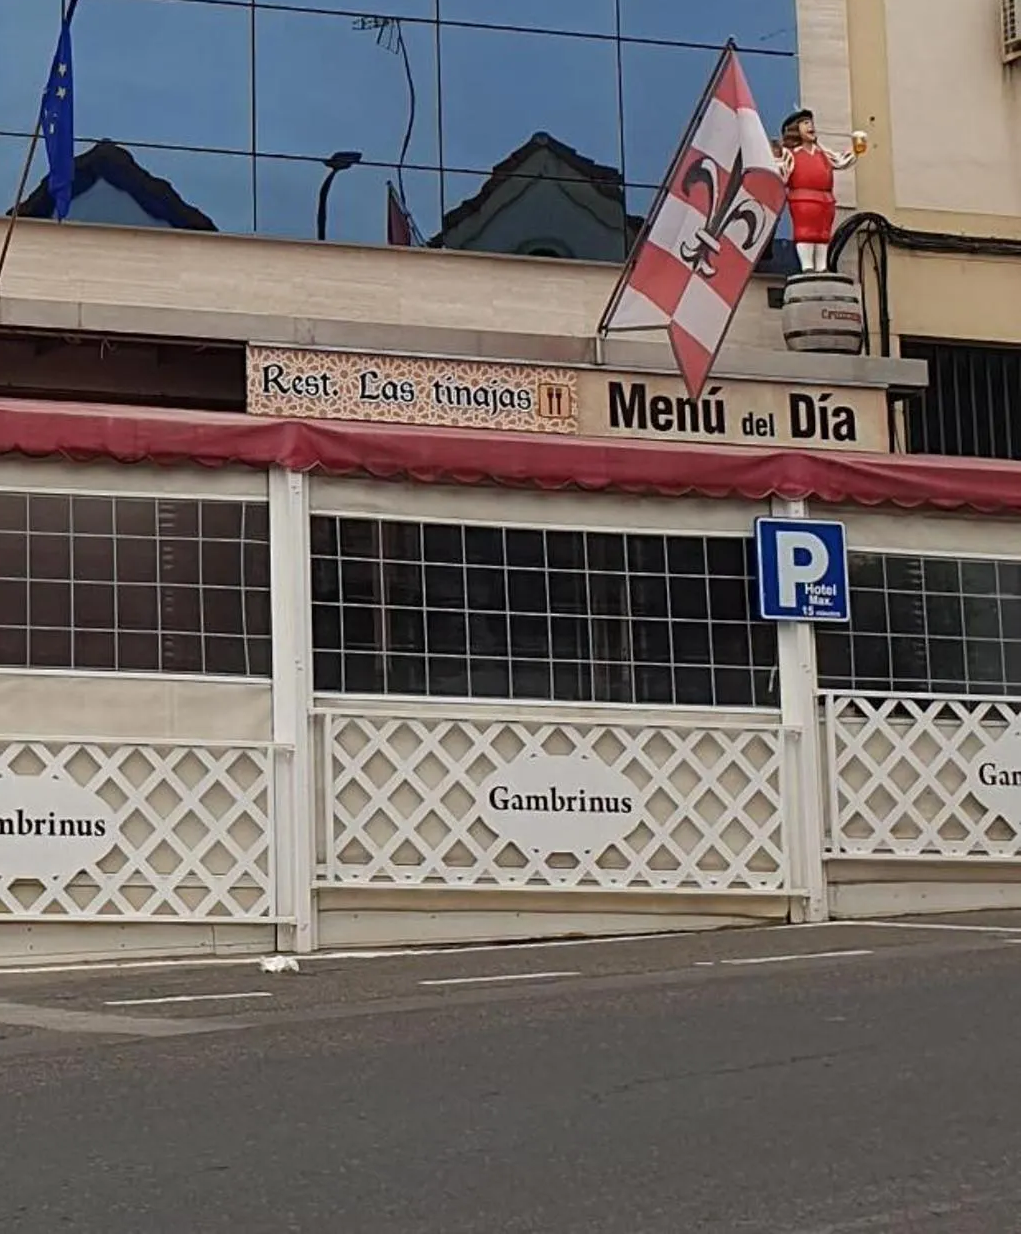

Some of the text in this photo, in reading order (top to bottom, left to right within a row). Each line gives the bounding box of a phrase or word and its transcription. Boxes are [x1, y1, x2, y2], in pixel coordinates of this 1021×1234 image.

[262, 364, 340, 398] Rest.
[358, 371, 416, 402] Las
[608, 381, 856, 441] Menú del Día
[775, 530, 829, 608] P
[804, 583, 837, 596] Hotel
[809, 595, 834, 606] Max.
[802, 605, 815, 616] 15
[489, 786, 632, 813] Gambrinus
